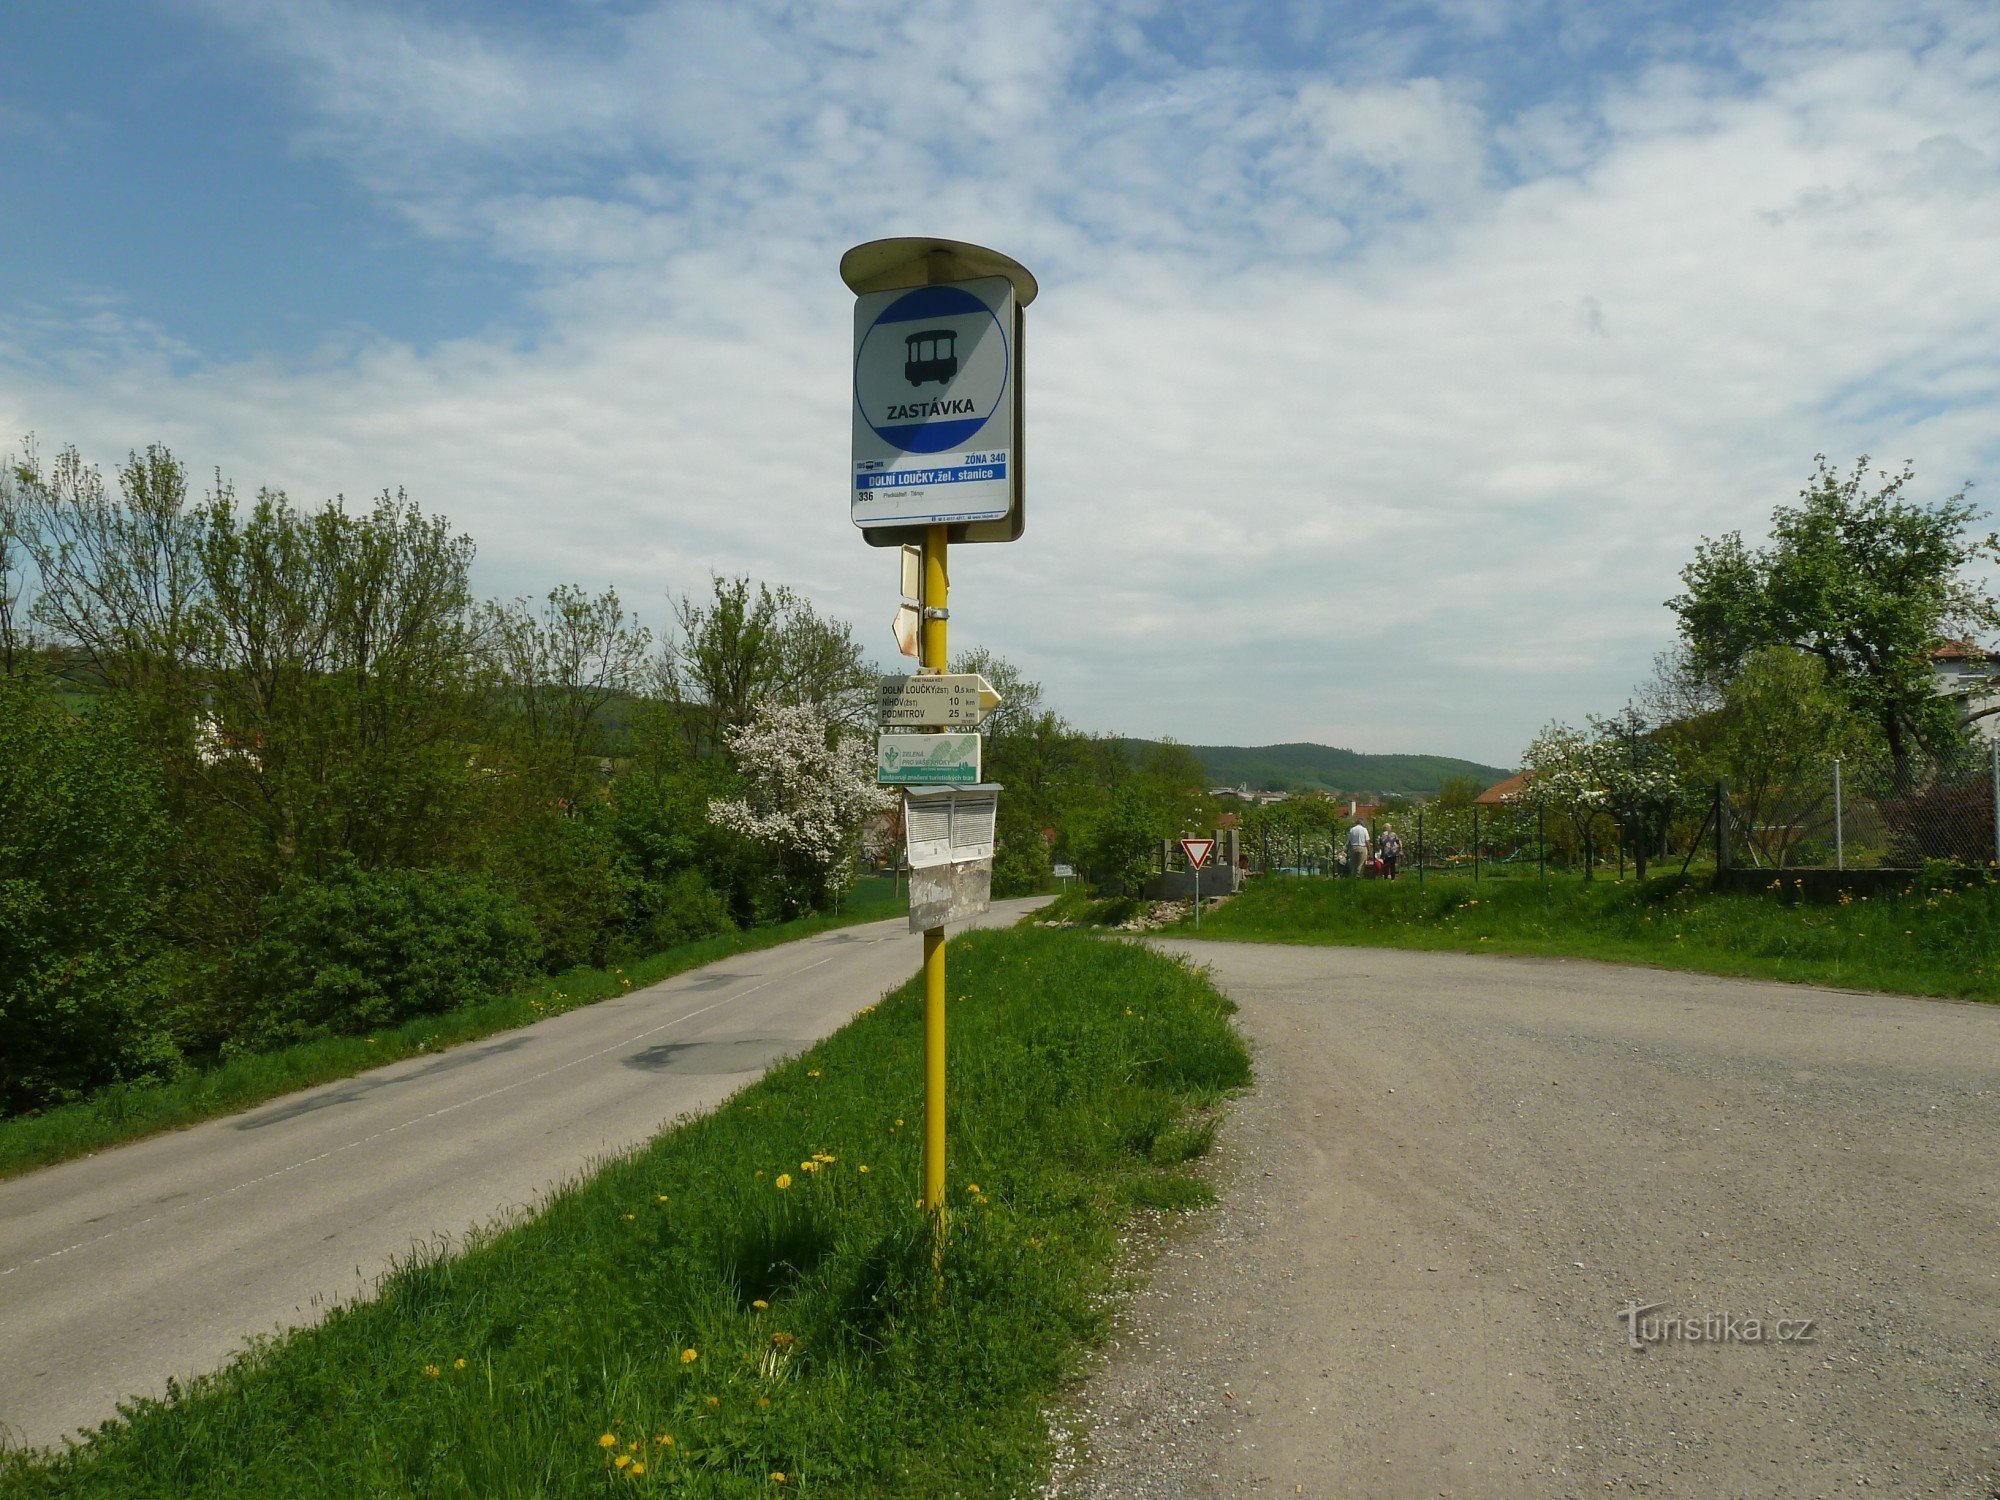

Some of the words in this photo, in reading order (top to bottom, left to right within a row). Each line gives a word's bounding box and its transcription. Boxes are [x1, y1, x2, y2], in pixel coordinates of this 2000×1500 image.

[887, 397, 975, 420] ZASTÁVKA
[965, 453, 987, 465] ZÓNA
[990, 453, 1006, 463] 340
[869, 473, 895, 487] DOLNÍ
[958, 468, 993, 480] stanice
[858, 491, 874, 501] 336
[882, 684, 904, 694] DOLNÍ
[949, 697, 960, 706] 10
[882, 710, 924, 718] PODMITROV
[949, 709, 960, 718] 25
